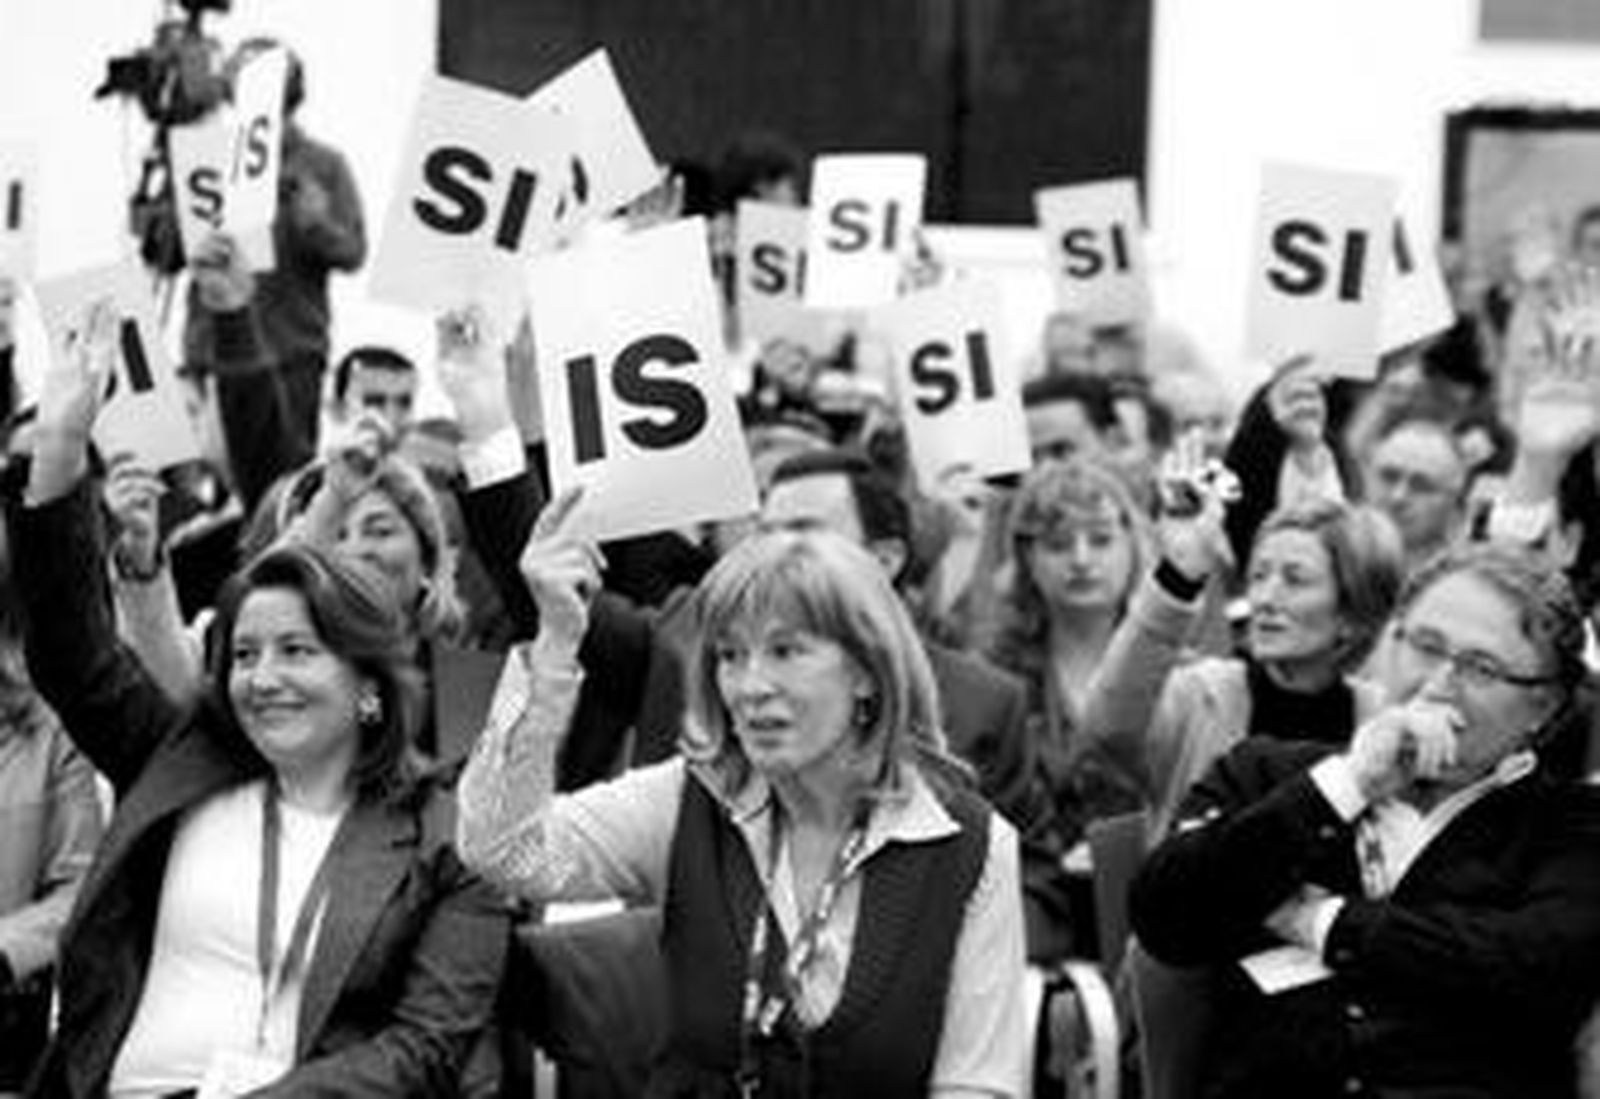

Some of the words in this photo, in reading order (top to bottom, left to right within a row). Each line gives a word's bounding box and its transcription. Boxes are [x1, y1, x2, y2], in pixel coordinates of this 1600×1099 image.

[187, 167, 224, 222] S
[412, 146, 538, 253] SI
[829, 201, 899, 253] SI
[751, 242, 807, 296] SI
[1060, 223, 1131, 280] SI
[1267, 219, 1368, 302] SI
[565, 334, 709, 465] IS
[909, 331, 995, 416] SI
